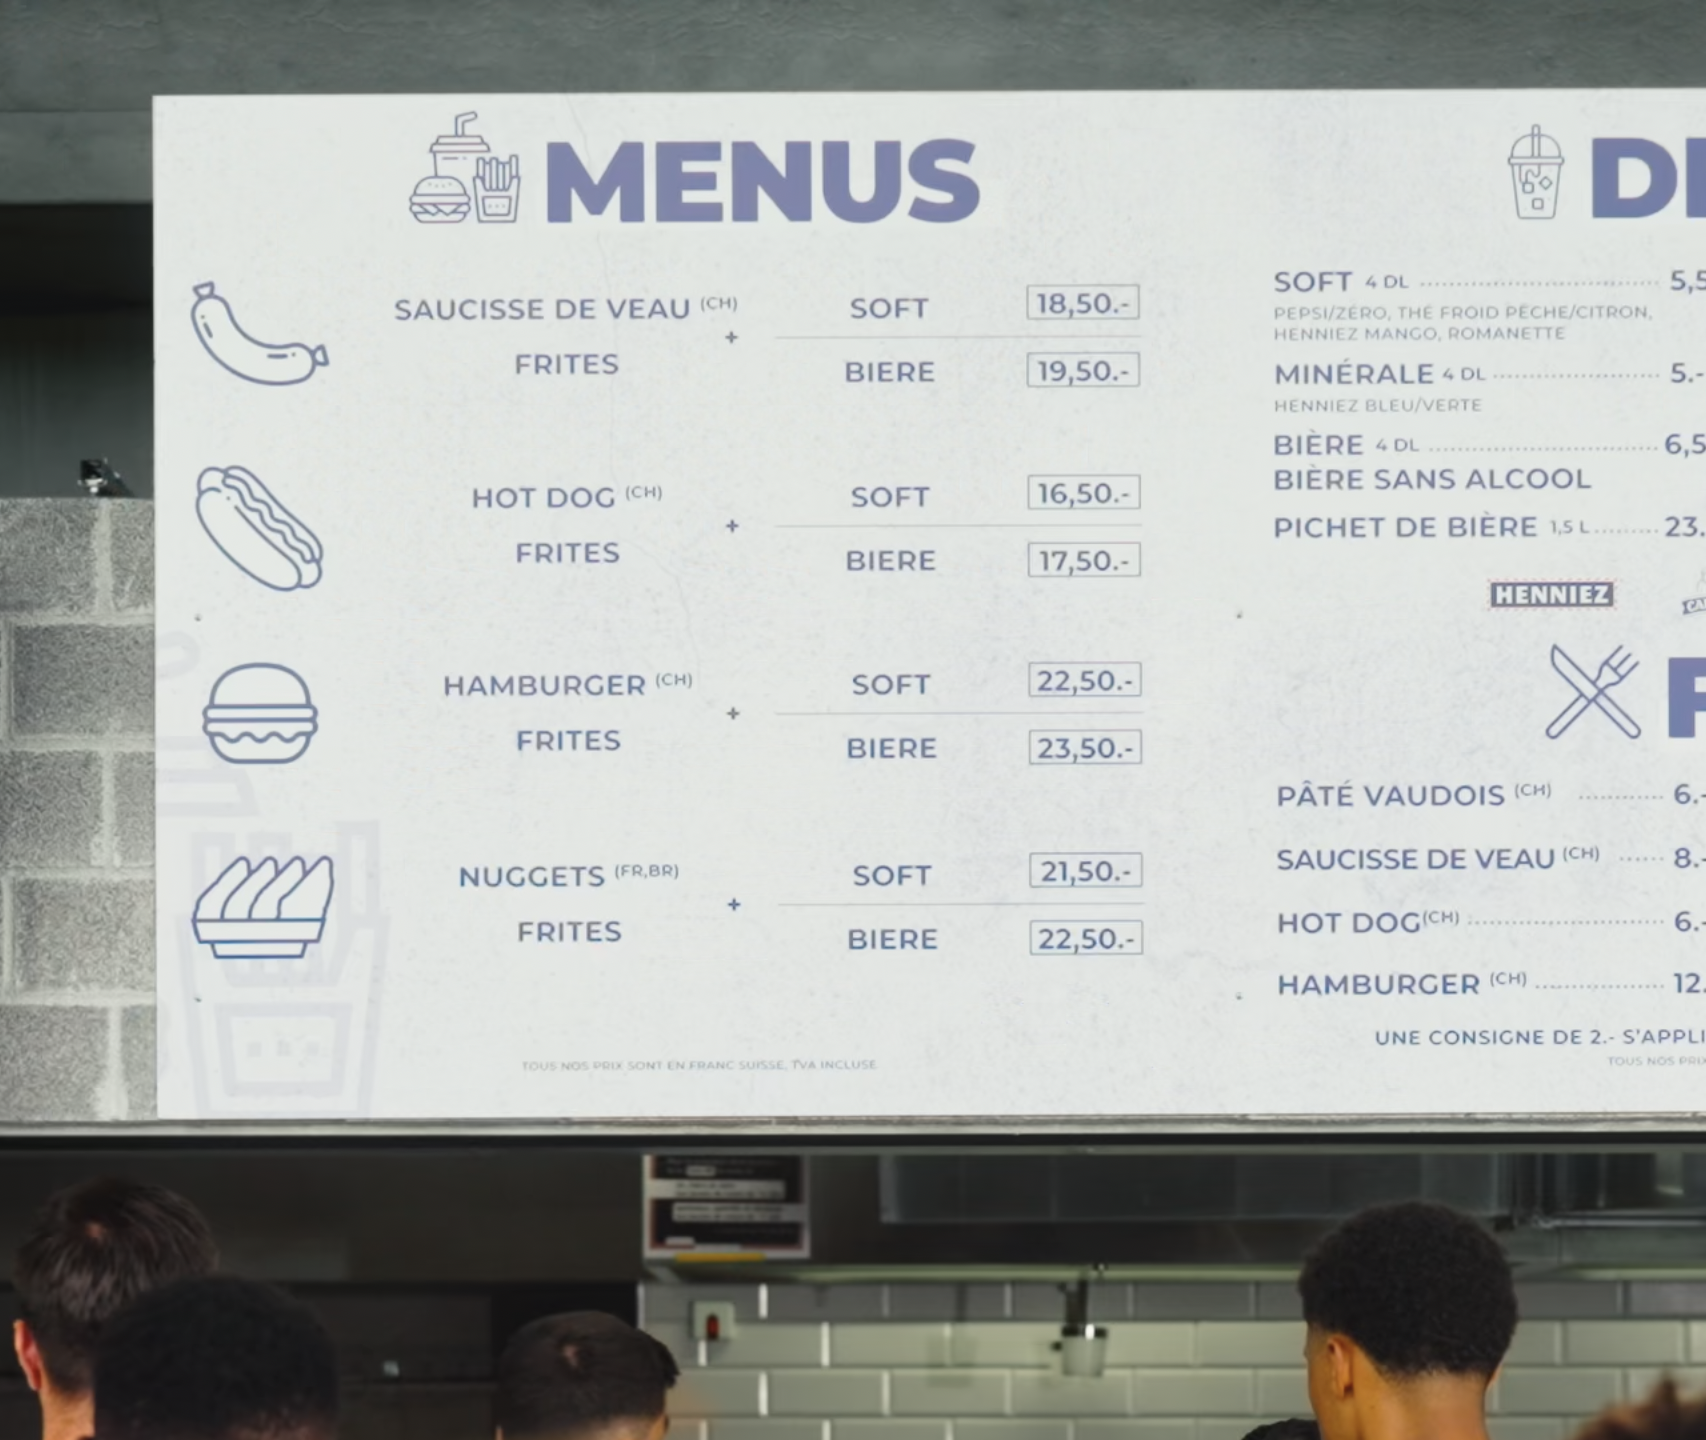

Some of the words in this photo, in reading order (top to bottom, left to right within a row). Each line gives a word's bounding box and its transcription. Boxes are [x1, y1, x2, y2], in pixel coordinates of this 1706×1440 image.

[547, 138, 980, 224] MENUS
[1274, 271, 1353, 293] SOFT
[1366, 276, 1377, 288] 4
[1384, 275, 1408, 288] DL
[395, 299, 544, 321] SAUCISSE
[556, 299, 596, 320] DE
[606, 298, 689, 320] VEAU
[701, 297, 737, 312] (CH)
[851, 298, 929, 319] SOFT
[1035, 293, 1129, 318] 18,50.-
[1440, 305, 1499, 320] FROID
[1274, 327, 1358, 341] HENNIEZ
[1365, 327, 1441, 342] MANGO,
[1448, 326, 1565, 340] ROMANETTE
[516, 353, 619, 375] FRITES
[846, 361, 935, 383] BIERE
[1036, 360, 1129, 386] 19,50.-
[1276, 358, 1434, 384] MINÉRALE
[1443, 368, 1454, 380] 4
[1461, 367, 1485, 381] DL
[1671, 362, 1704, 383] 5.-
[1275, 398, 1358, 413] HENNIEZ
[1365, 396, 1481, 413] BLEU/VERTE
[1274, 429, 1363, 455] BIÈRE
[1376, 439, 1387, 451] 4
[1394, 438, 1419, 452] DL
[1275, 464, 1364, 490] BIÈRE
[1374, 469, 1456, 490] SANS
[1465, 468, 1592, 490] ALCOOL
[473, 487, 537, 509] HOT
[547, 487, 615, 508] DOG
[626, 486, 662, 501] (CH)
[851, 486, 930, 508] SOFT
[1036, 483, 1129, 508] 16,50.-
[1275, 517, 1386, 538] PICHET
[1396, 517, 1436, 538] DE
[1448, 511, 1537, 537] BIÈRE
[1550, 520, 1573, 535] 1,5
[1580, 520, 1590, 534] L
[517, 542, 620, 563] FRITES
[847, 550, 936, 571] BIERE
[1036, 550, 1129, 575] 17,50.-
[1496, 585, 1609, 604] HENNIEZ
[445, 674, 645, 697] HAMBURGER
[656, 673, 692, 688] (CH)
[853, 674, 931, 695] SOFT
[1035, 670, 1133, 695] 22,50.-
[517, 730, 621, 751] FRITES
[848, 737, 937, 759] BIERE
[1036, 737, 1133, 763] 23,50.-
[1278, 780, 1353, 807] PÂTÉ
[1363, 785, 1505, 806] VAUDOIS
[1514, 782, 1551, 799] (CH)
[1277, 849, 1418, 871] SAUCISSE
[1428, 849, 1467, 870] DE
[1475, 848, 1555, 870] VEAU
[1563, 845, 1600, 863] (CH)
[460, 865, 605, 888] NUGGETS
[615, 864, 679, 879] (FR,BR)
[853, 865, 932, 886] SOFT
[1039, 860, 1131, 886] 21,50.-
[518, 921, 622, 942] FRITES
[1278, 912, 1342, 934] HOT
[848, 929, 938, 950] BIERE
[1036, 928, 1133, 953] 22,50.-
[1279, 973, 1480, 996] HAMBURGER
[1490, 971, 1527, 988] (CH)
[1376, 1030, 1420, 1046] UNE
[1429, 1030, 1544, 1045] CONSIGNE
[1553, 1029, 1582, 1044] DE
[1590, 1029, 1615, 1045] 2.-
[821, 1060, 876, 1069] INCLUSE
